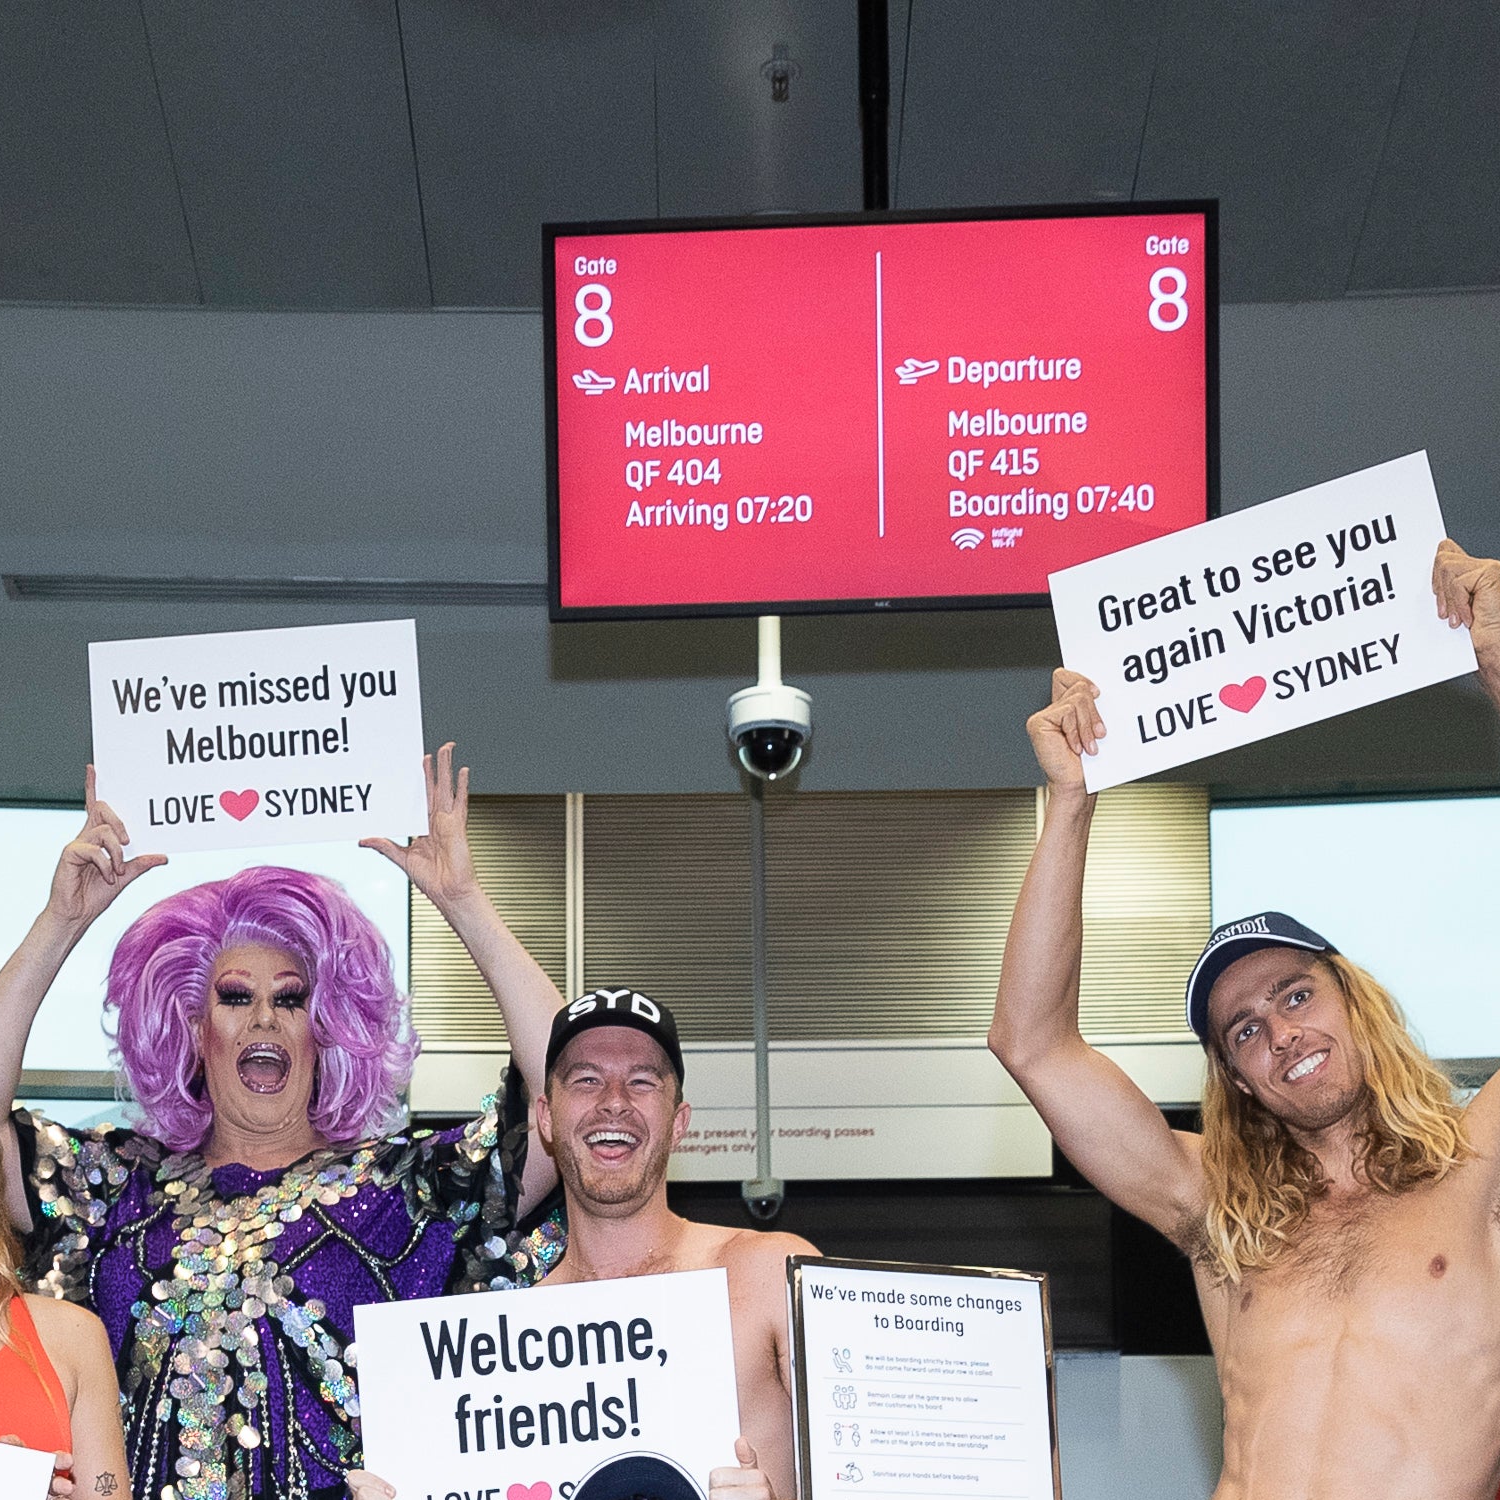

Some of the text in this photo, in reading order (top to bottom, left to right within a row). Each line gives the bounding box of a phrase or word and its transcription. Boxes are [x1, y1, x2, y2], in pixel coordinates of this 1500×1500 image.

[1146, 234, 1189, 257] Gate
[574, 256, 617, 278] Gate
[574, 283, 614, 348] 8
[1148, 266, 1189, 332] 8
[624, 364, 710, 396] Arrival
[948, 354, 1081, 387] Departure
[624, 419, 763, 449] Melbourne
[948, 408, 1088, 438] Melbourne
[625, 458, 721, 491] QF 404
[948, 447, 1040, 481] QF 415
[625, 494, 813, 531] Arriving 07:20
[949, 484, 1155, 522] Boarding 07:40
[1099, 514, 1397, 632] Great to see you
[1123, 563, 1395, 684] again Victoria!
[113, 665, 397, 714] We've missed you
[1138, 634, 1400, 744] LOVE SYDNEY
[167, 717, 349, 764] Melbourne!
[150, 784, 371, 825] LOVE SYDNEY
[568, 990, 660, 1023] SYD
[703, 1128, 748, 1140] present
[778, 1126, 831, 1138] boarding
[834, 1127, 876, 1138] passes
[810, 1284, 1022, 1314] We've made some changes
[873, 1314, 964, 1337] to Boarding
[420, 1314, 668, 1380] Welcome,
[455, 1378, 640, 1453] friends!
